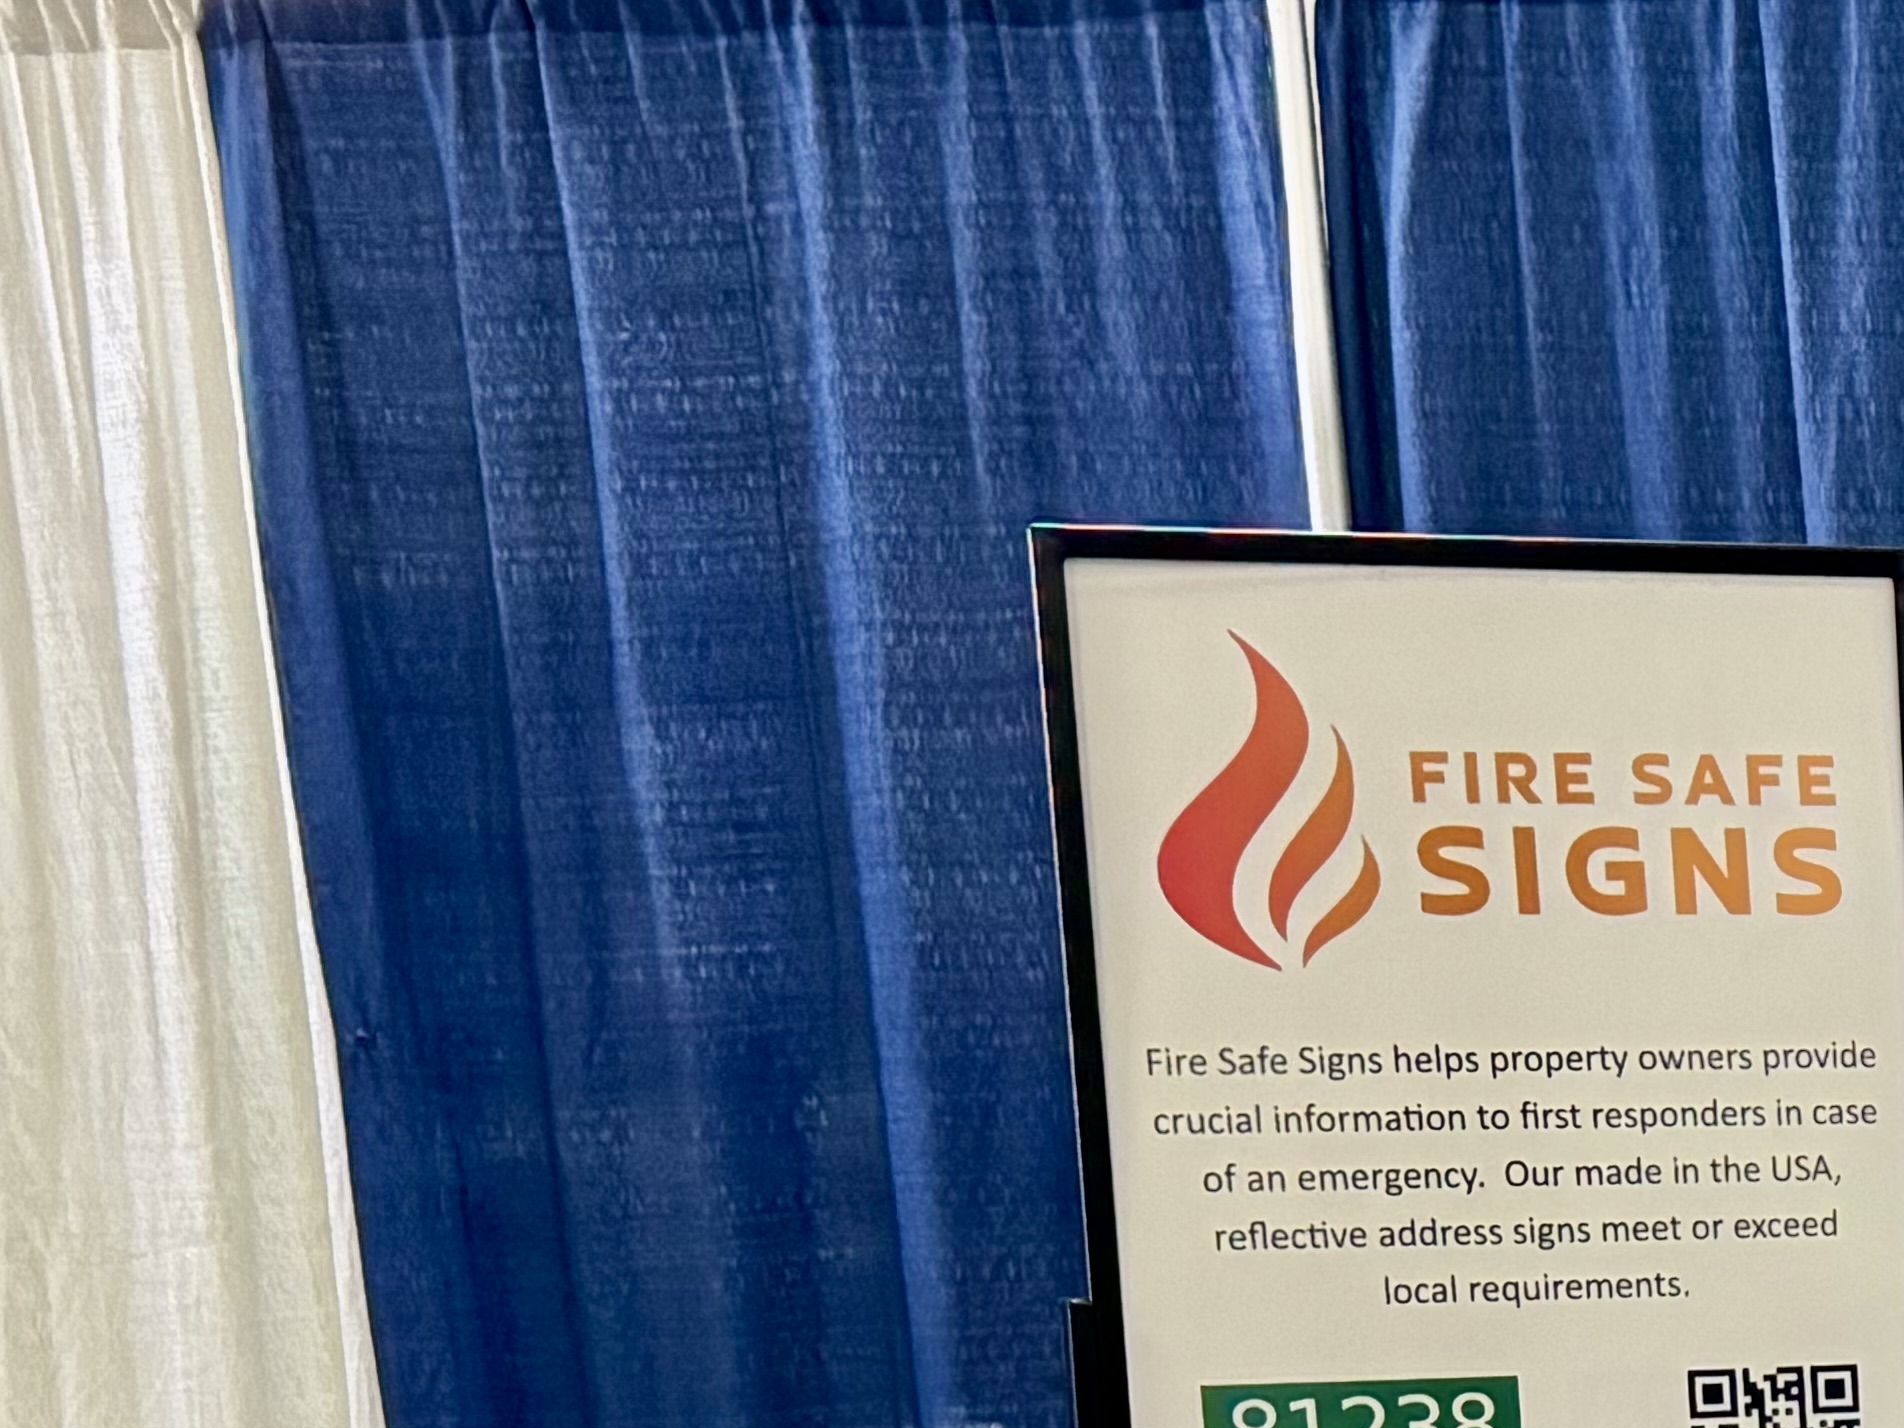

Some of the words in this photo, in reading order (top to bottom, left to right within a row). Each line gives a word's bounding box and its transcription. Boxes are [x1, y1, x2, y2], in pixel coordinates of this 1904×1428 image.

[1408, 750, 1595, 805] FIRE
[1631, 752, 1837, 807] SAFE
[1416, 825, 1843, 917] SIGNS
[1146, 1047, 1208, 1077] Fire
[1218, 1044, 1288, 1076] Safe
[1298, 1045, 1383, 1081] Signs
[1393, 1043, 1479, 1080] helps
[1490, 1045, 1628, 1080] property
[1638, 1048, 1753, 1071] owners
[1762, 1039, 1876, 1077] provide
[1153, 1103, 1262, 1135] crucial
[1273, 1102, 1467, 1134] information
[1476, 1105, 1510, 1130] to
[1519, 1100, 1582, 1130] first
[1592, 1098, 1766, 1135] responders
[1776, 1098, 1803, 1127] in
[1812, 1104, 1877, 1125] case
[1203, 1162, 1237, 1193] of
[1247, 1170, 1286, 1193] an
[1297, 1167, 1485, 1197] emergency.
[1504, 1160, 1565, 1187] Our
[1575, 1156, 1662, 1187] made
[1673, 1156, 1699, 1185] in
[1709, 1154, 1761, 1184] the
[1771, 1154, 1841, 1187] USA,
[1215, 1220, 1367, 1252] reflective
[1378, 1217, 1503, 1248] address
[1513, 1216, 1591, 1251] signs
[1602, 1216, 1682, 1243] meet
[1691, 1219, 1724, 1240] or
[1733, 1208, 1838, 1239] exceed
[1384, 1274, 1457, 1305] local
[1469, 1272, 1690, 1309] requirements.
